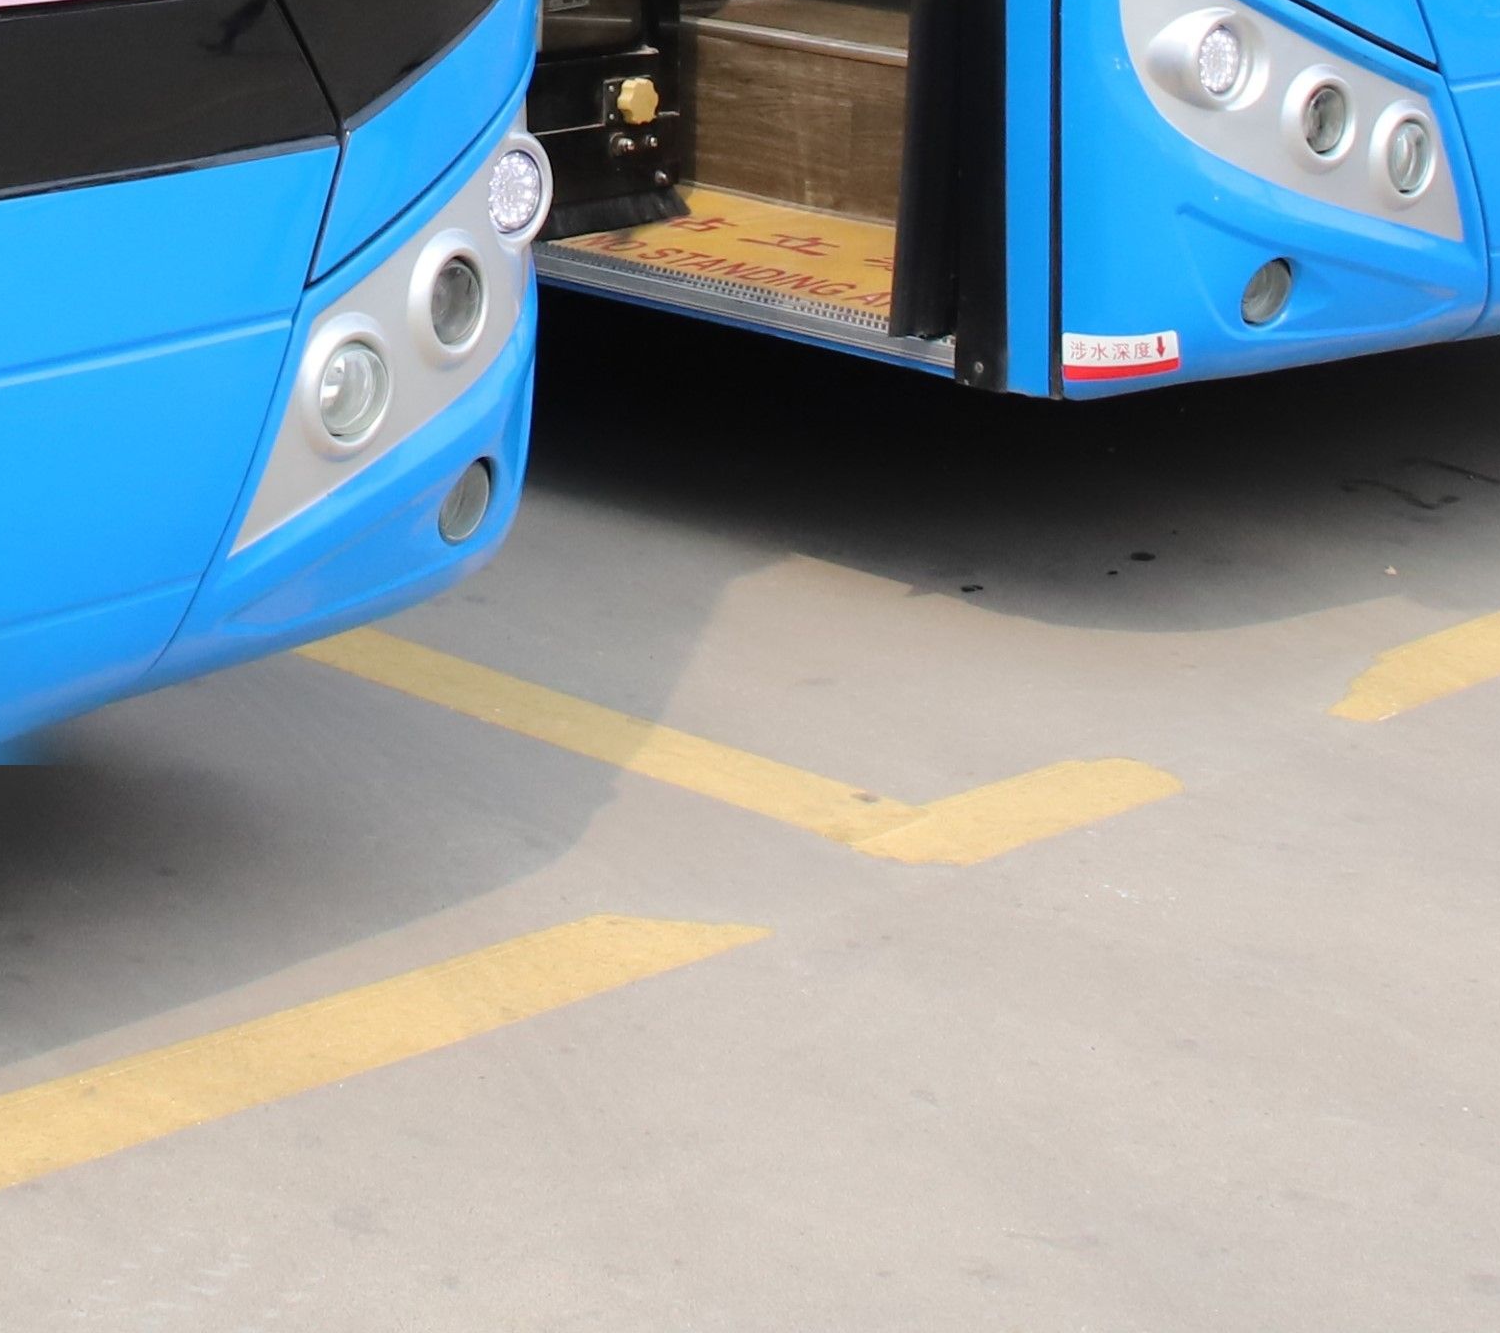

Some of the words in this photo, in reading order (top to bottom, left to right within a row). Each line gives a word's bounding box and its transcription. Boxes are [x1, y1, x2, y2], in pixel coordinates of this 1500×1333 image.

[574, 234, 646, 253] NO
[638, 247, 857, 296] STANDING
[1070, 340, 1153, 360] 涉水深度
